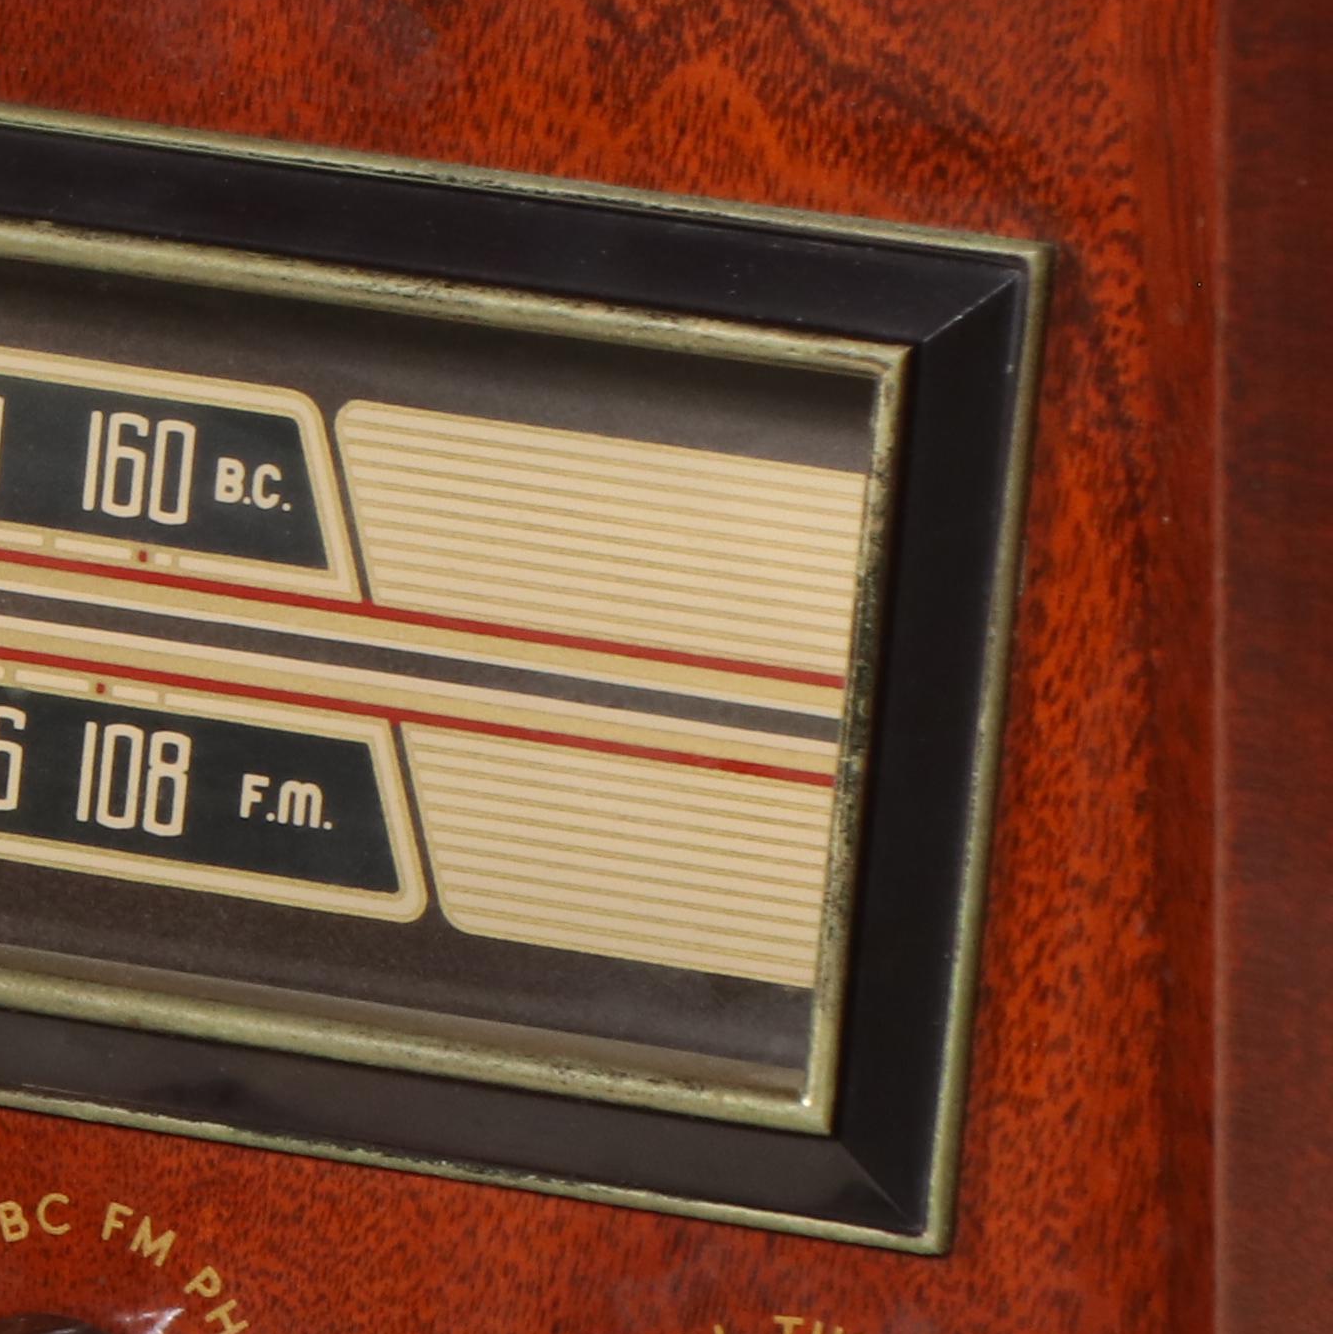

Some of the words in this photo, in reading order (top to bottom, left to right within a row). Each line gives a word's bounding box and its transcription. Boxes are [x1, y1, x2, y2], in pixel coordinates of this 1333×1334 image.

[82, 410, 196, 525] 160
[214, 457, 291, 512] B.C.
[76, 721, 192, 837] 108
[101, 1202, 176, 1267] FM
